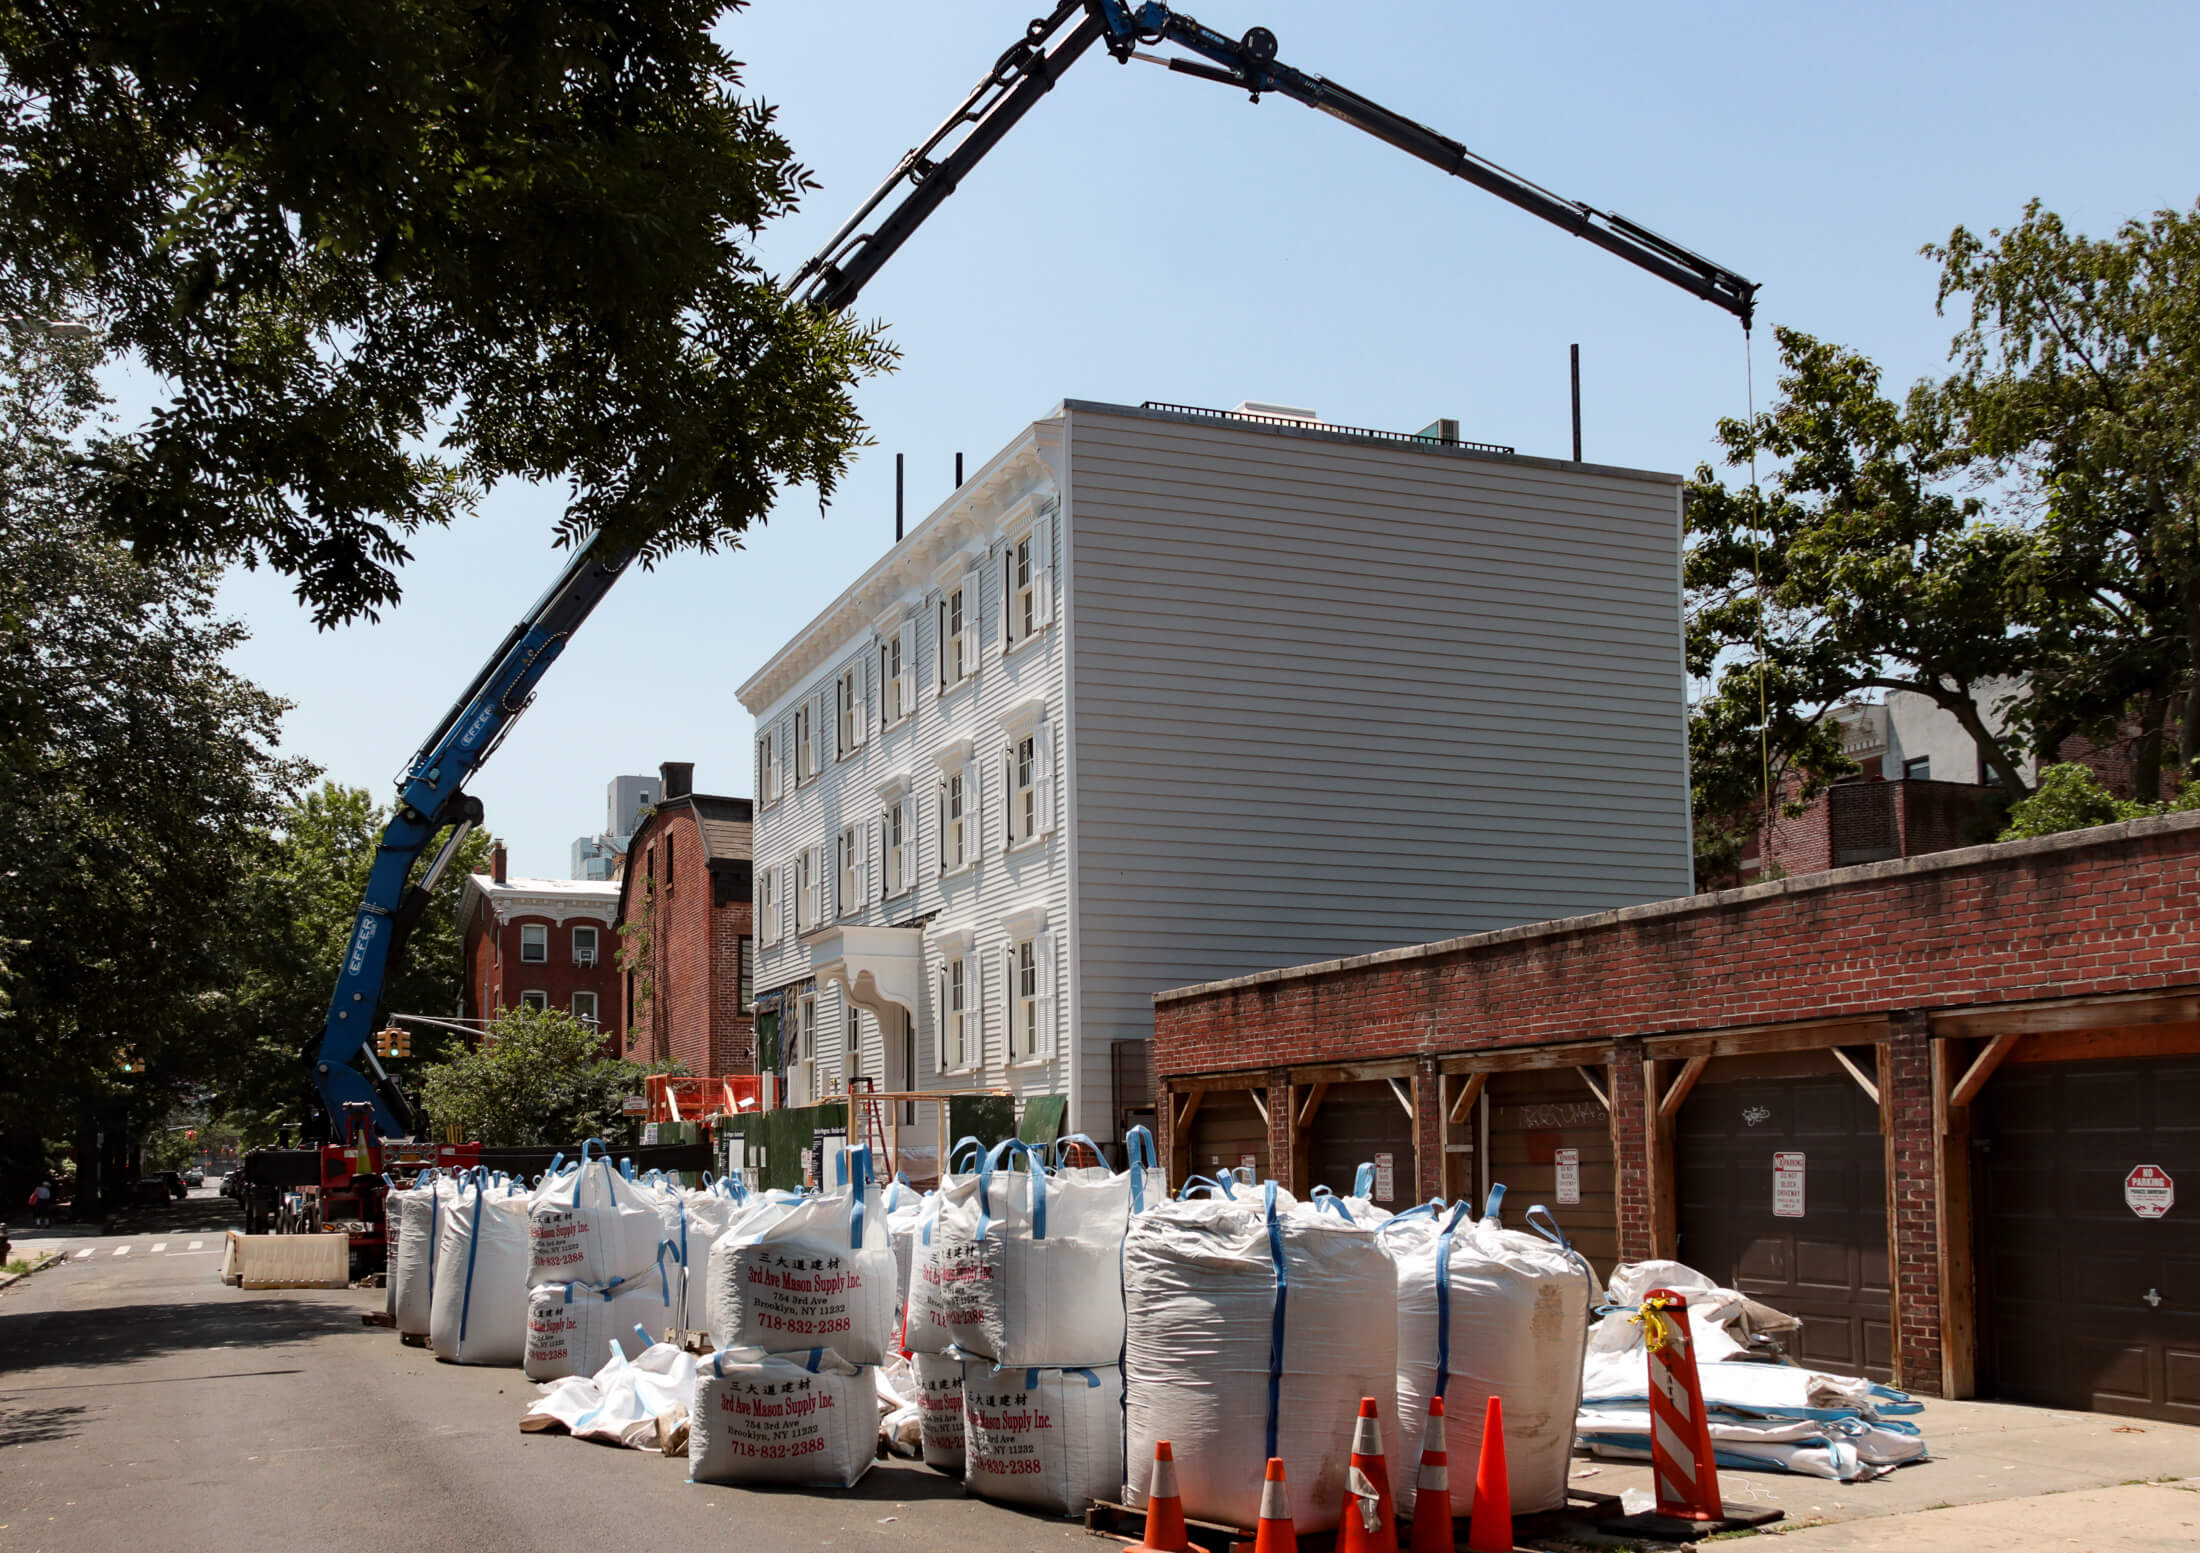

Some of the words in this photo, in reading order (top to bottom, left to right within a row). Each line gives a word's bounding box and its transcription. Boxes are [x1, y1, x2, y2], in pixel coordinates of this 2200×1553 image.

[349, 918, 371, 970] EFFER
[2143, 1168, 2153, 1177] NO
[2132, 1178, 2165, 1187] PARKING
[556, 1223, 576, 1238] Supply
[577, 1221, 590, 1233] Inc.
[760, 1252, 841, 1271] 三大道建材
[748, 1265, 762, 1284] 3rd
[764, 1268, 780, 1288] Ave
[782, 1271, 812, 1293] Mason
[814, 1272, 845, 1296] Supply
[847, 1271, 862, 1289] Inc.
[754, 1297, 798, 1316] Brooklyn,
[801, 1307, 816, 1315] NY
[820, 1304, 846, 1315] 11232
[773, 1292, 789, 1303] 754
[792, 1295, 808, 1305] 3rd
[810, 1297, 828, 1306] Ave
[758, 1312, 851, 1334] 718-832-2388
[730, 1377, 812, 1395] 三大道建材
[721, 1393, 734, 1413] 3rd
[736, 1395, 751, 1415] Ave
[753, 1398, 783, 1417] Mason
[785, 1392, 816, 1417] Supply
[818, 1391, 835, 1408] Inc.
[745, 1420, 761, 1429] 754
[763, 1421, 779, 1431] 3rd
[782, 1420, 800, 1429] Ave
[1002, 1409, 1032, 1434] Supply
[1034, 1409, 1052, 1428] Inc.
[728, 1425, 770, 1441] Brooklyn,
[773, 1431, 788, 1439] NY
[792, 1425, 818, 1438] 11232
[1001, 1435, 1015, 1443] Ave
[732, 1437, 825, 1459] 718-832-2388
[994, 1446, 1006, 1454] NY
[1009, 1445, 1034, 1454] 11232
